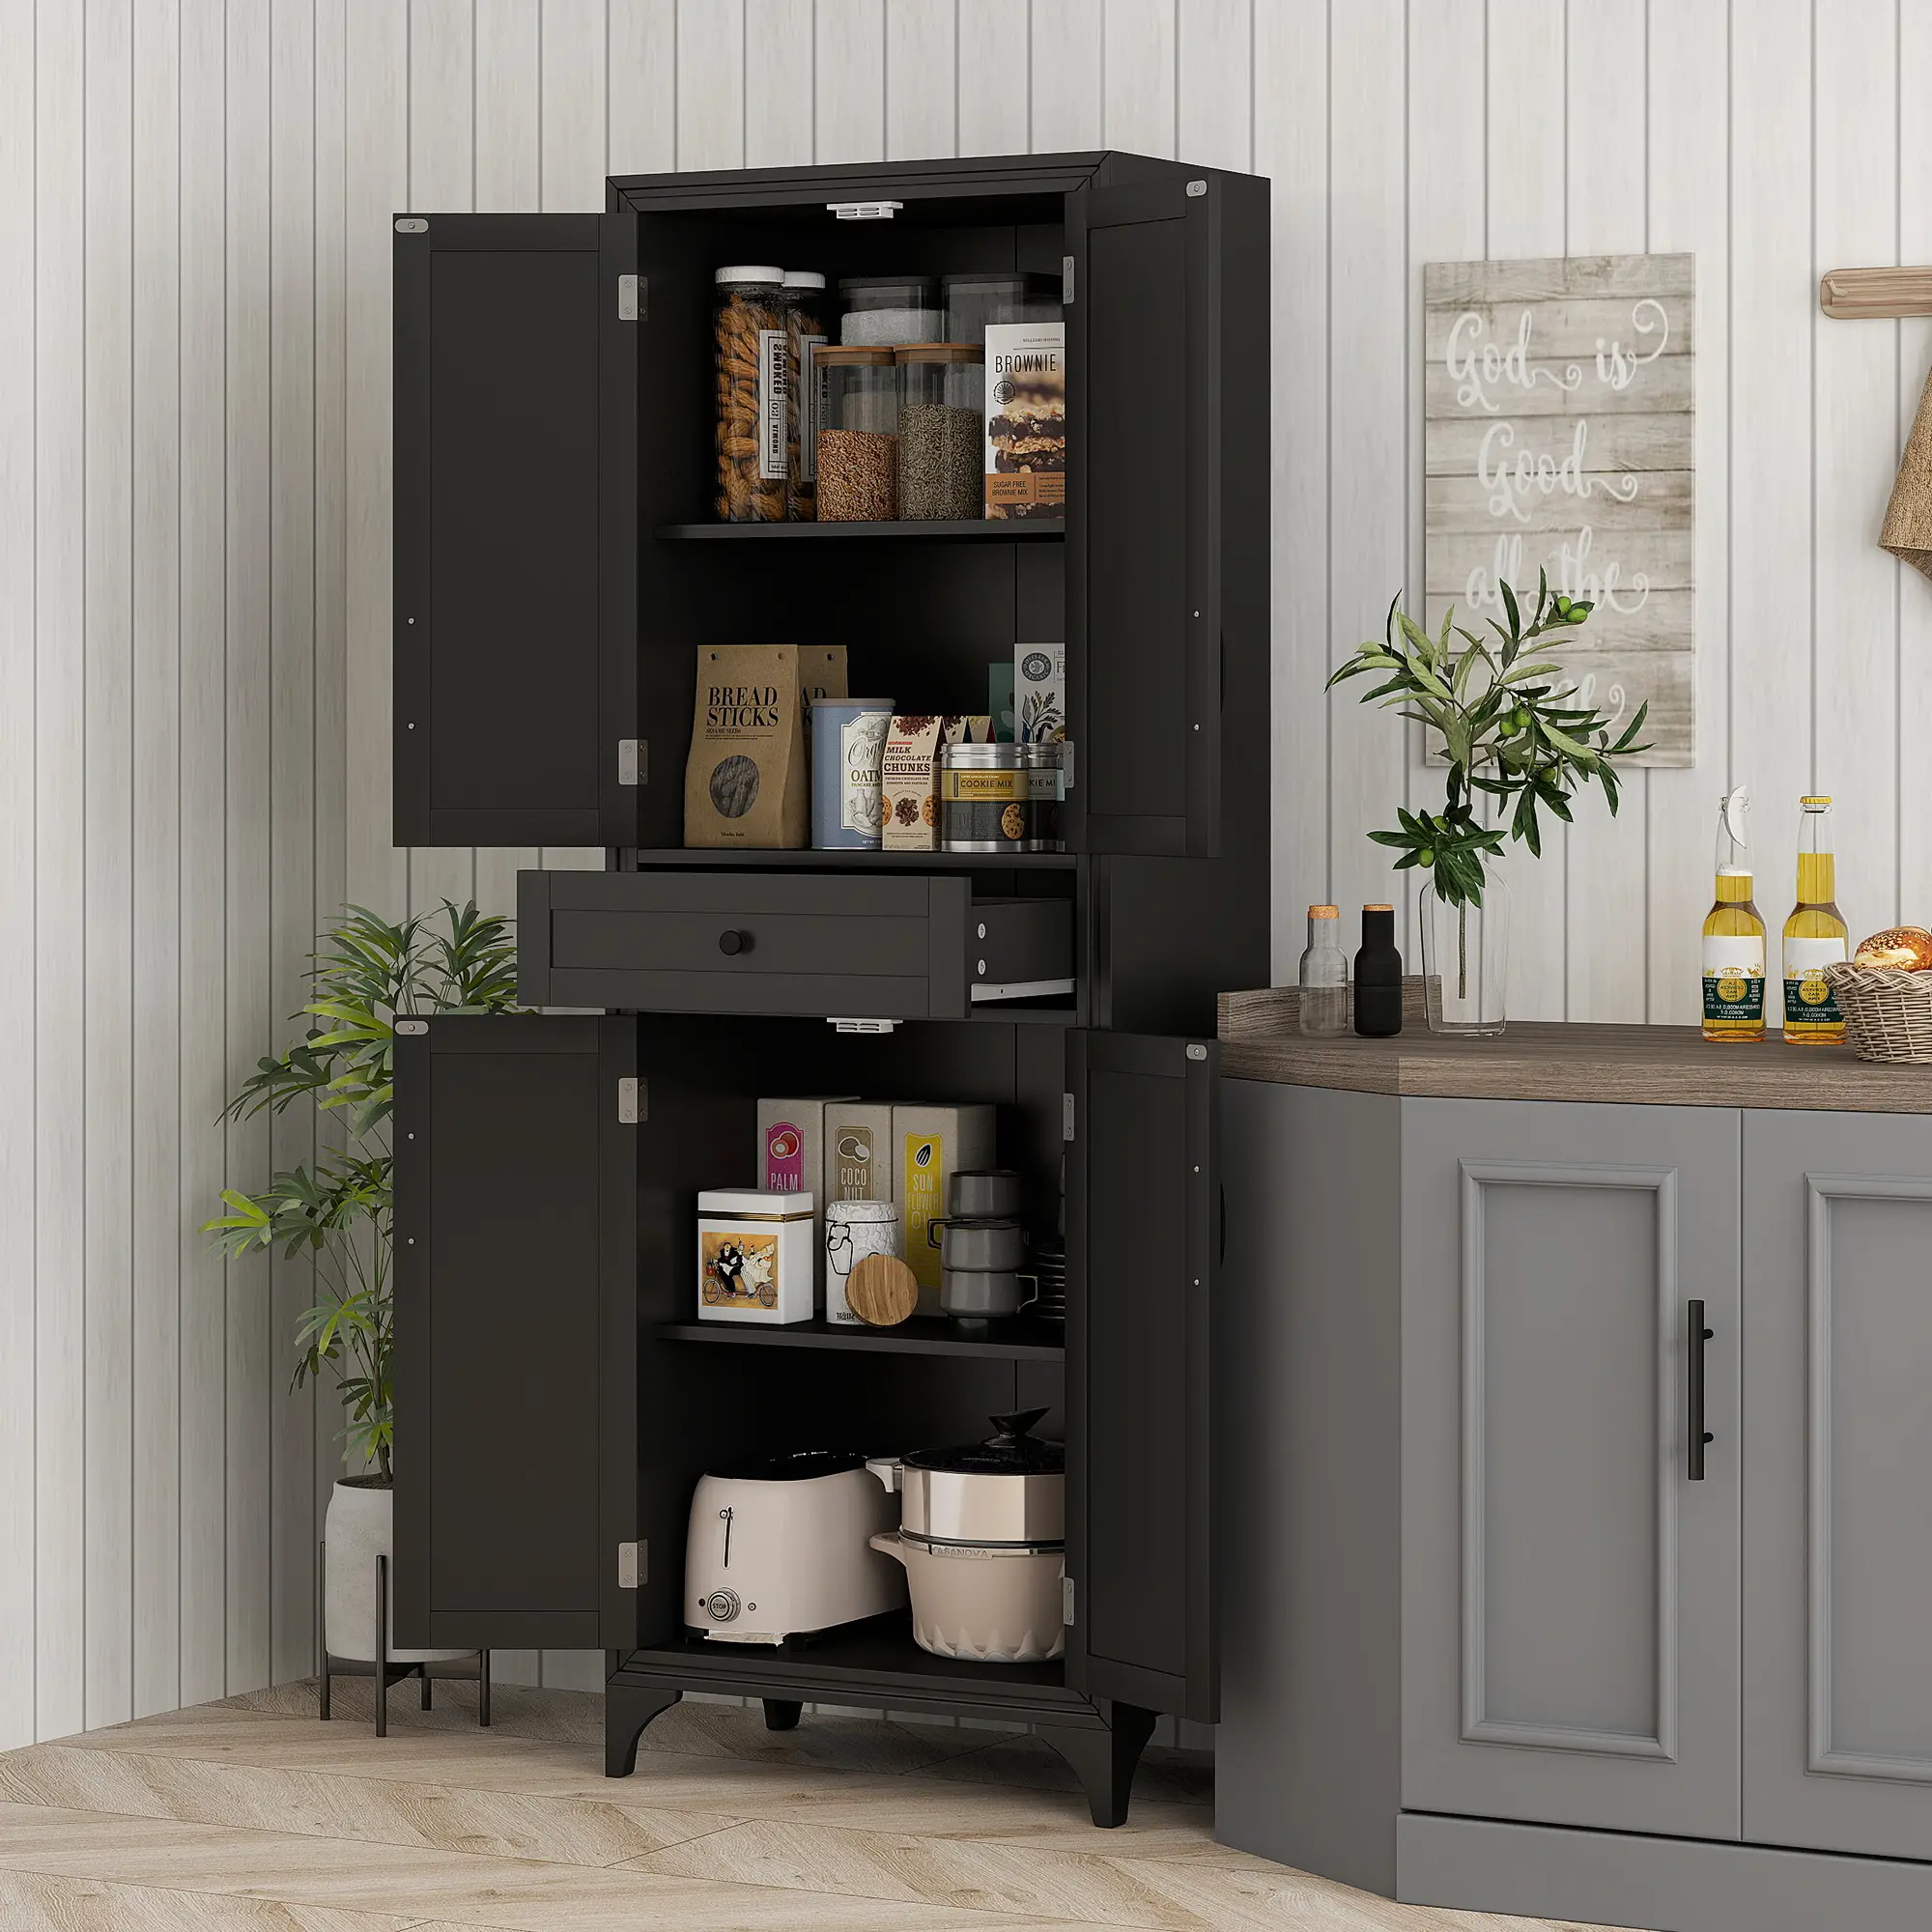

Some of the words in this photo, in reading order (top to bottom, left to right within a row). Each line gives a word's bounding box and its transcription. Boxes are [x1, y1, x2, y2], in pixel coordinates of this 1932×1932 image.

[995, 354, 1057, 373] BROWNIE
[1446, 309, 1582, 412] God
[1596, 298, 1669, 391] is
[1477, 418, 1638, 523] Good
[1546, 526, 1649, 614] the
[706, 686, 778, 707] BREAD
[706, 707, 780, 727] STICKS
[851, 769, 883, 782] OATM
[883, 763, 931, 772] CHUNKS
[960, 780, 995, 788] COOKIE
[997, 780, 1013, 788] MIX
[1029, 779, 1043, 787] KIE
[1046, 779, 1056, 787] MI
[771, 1172, 798, 1191] PALM
[840, 1167, 867, 1186] COCO
[913, 1172, 933, 1191] SUN
[844, 1186, 864, 1201] NUT
[908, 1192, 938, 1210] FLOWER
